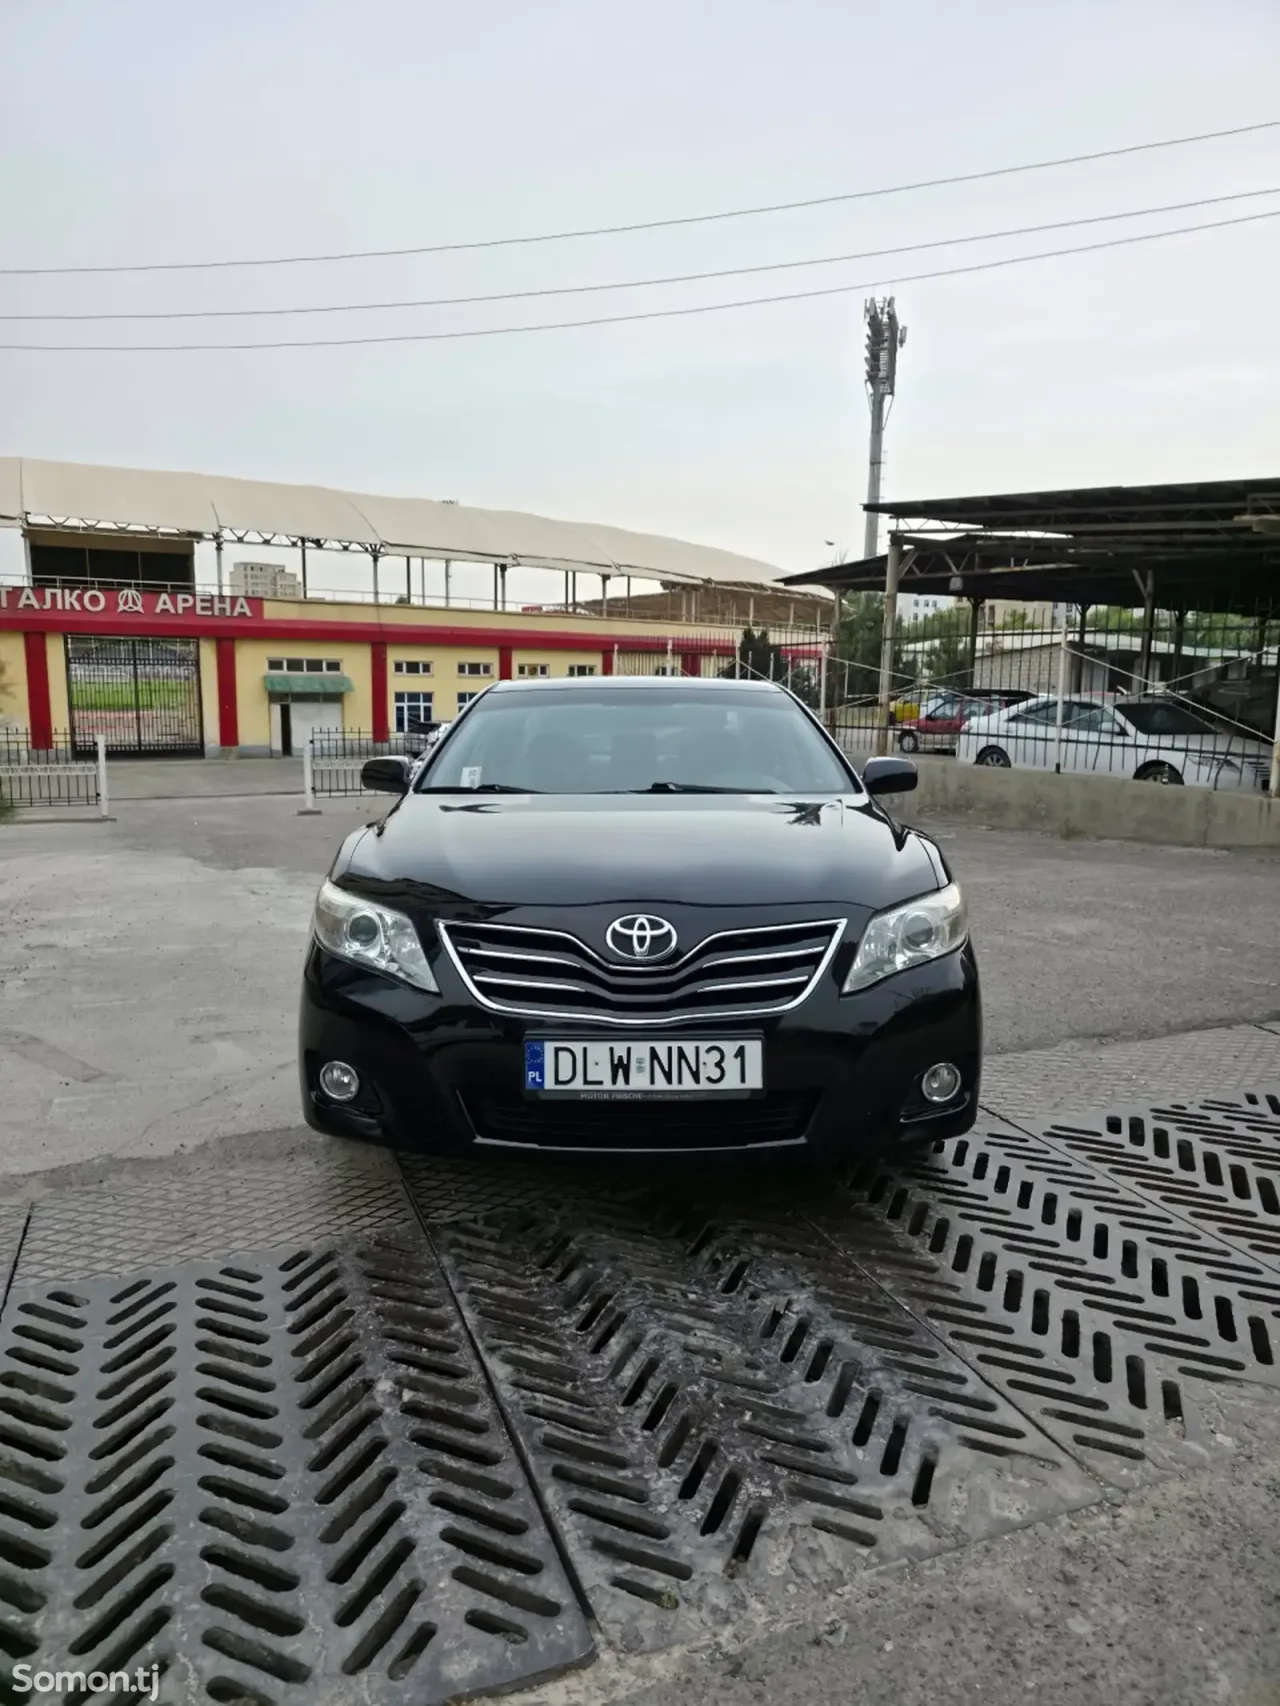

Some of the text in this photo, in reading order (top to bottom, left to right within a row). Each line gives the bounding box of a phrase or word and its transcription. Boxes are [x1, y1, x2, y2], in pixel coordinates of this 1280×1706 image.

[0, 587, 253, 617] ТАЛКО АРЕНА
[528, 1071, 542, 1082] PL
[553, 1044, 746, 1086] DLW NN31
